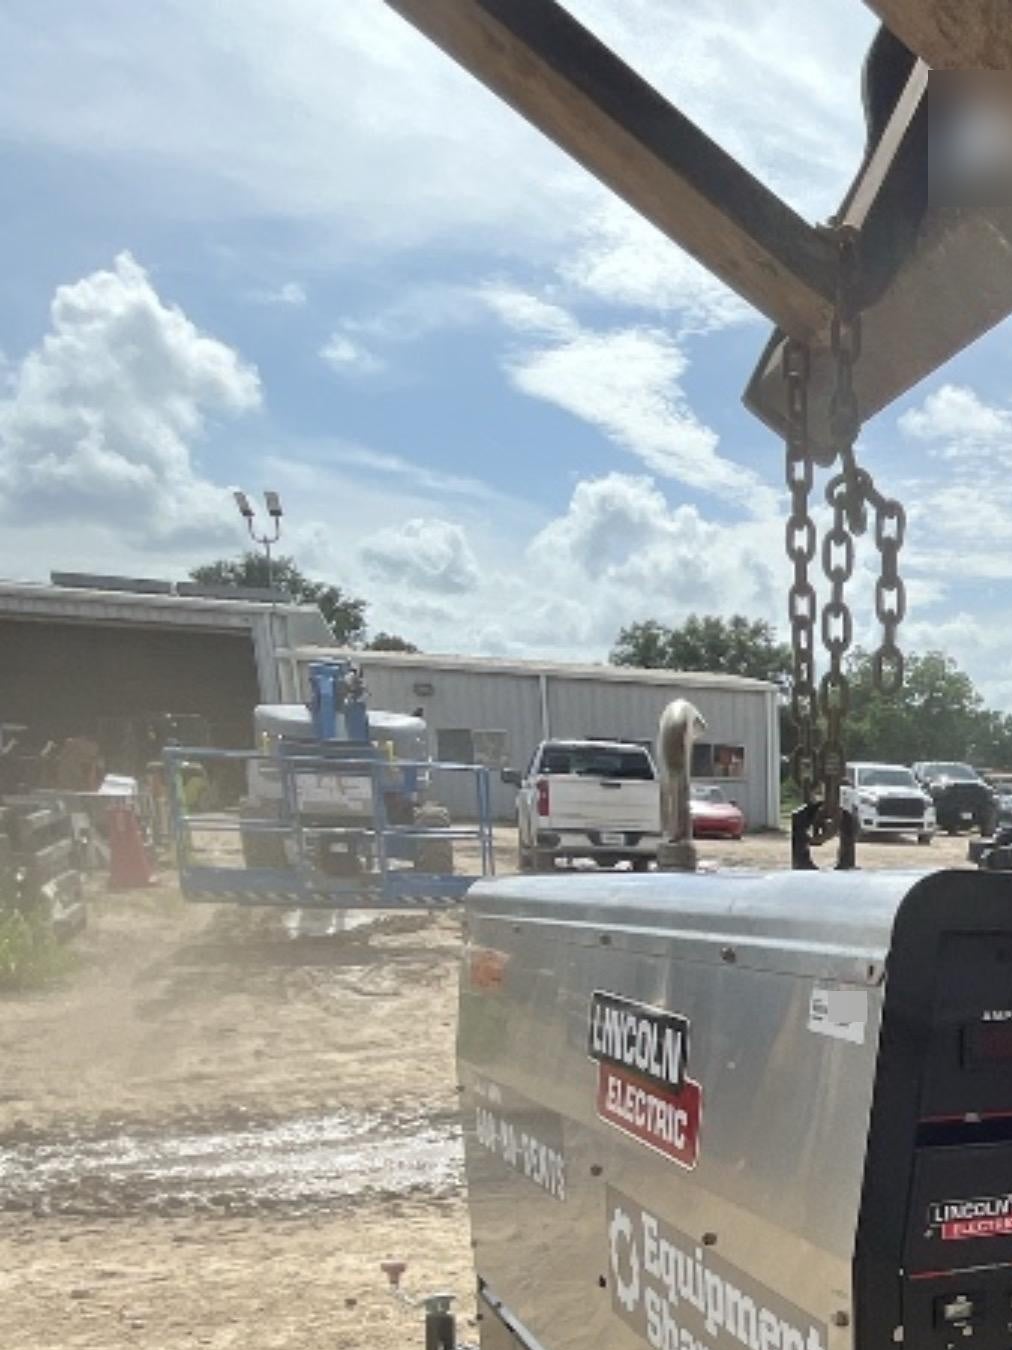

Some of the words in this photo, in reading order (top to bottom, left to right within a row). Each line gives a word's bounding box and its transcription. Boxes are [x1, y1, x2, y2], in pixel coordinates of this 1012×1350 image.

[593, 1004, 682, 1085] LINCOLN
[605, 1075, 690, 1151] ELECTRIC
[934, 1199, 1010, 1222] LINCOLN
